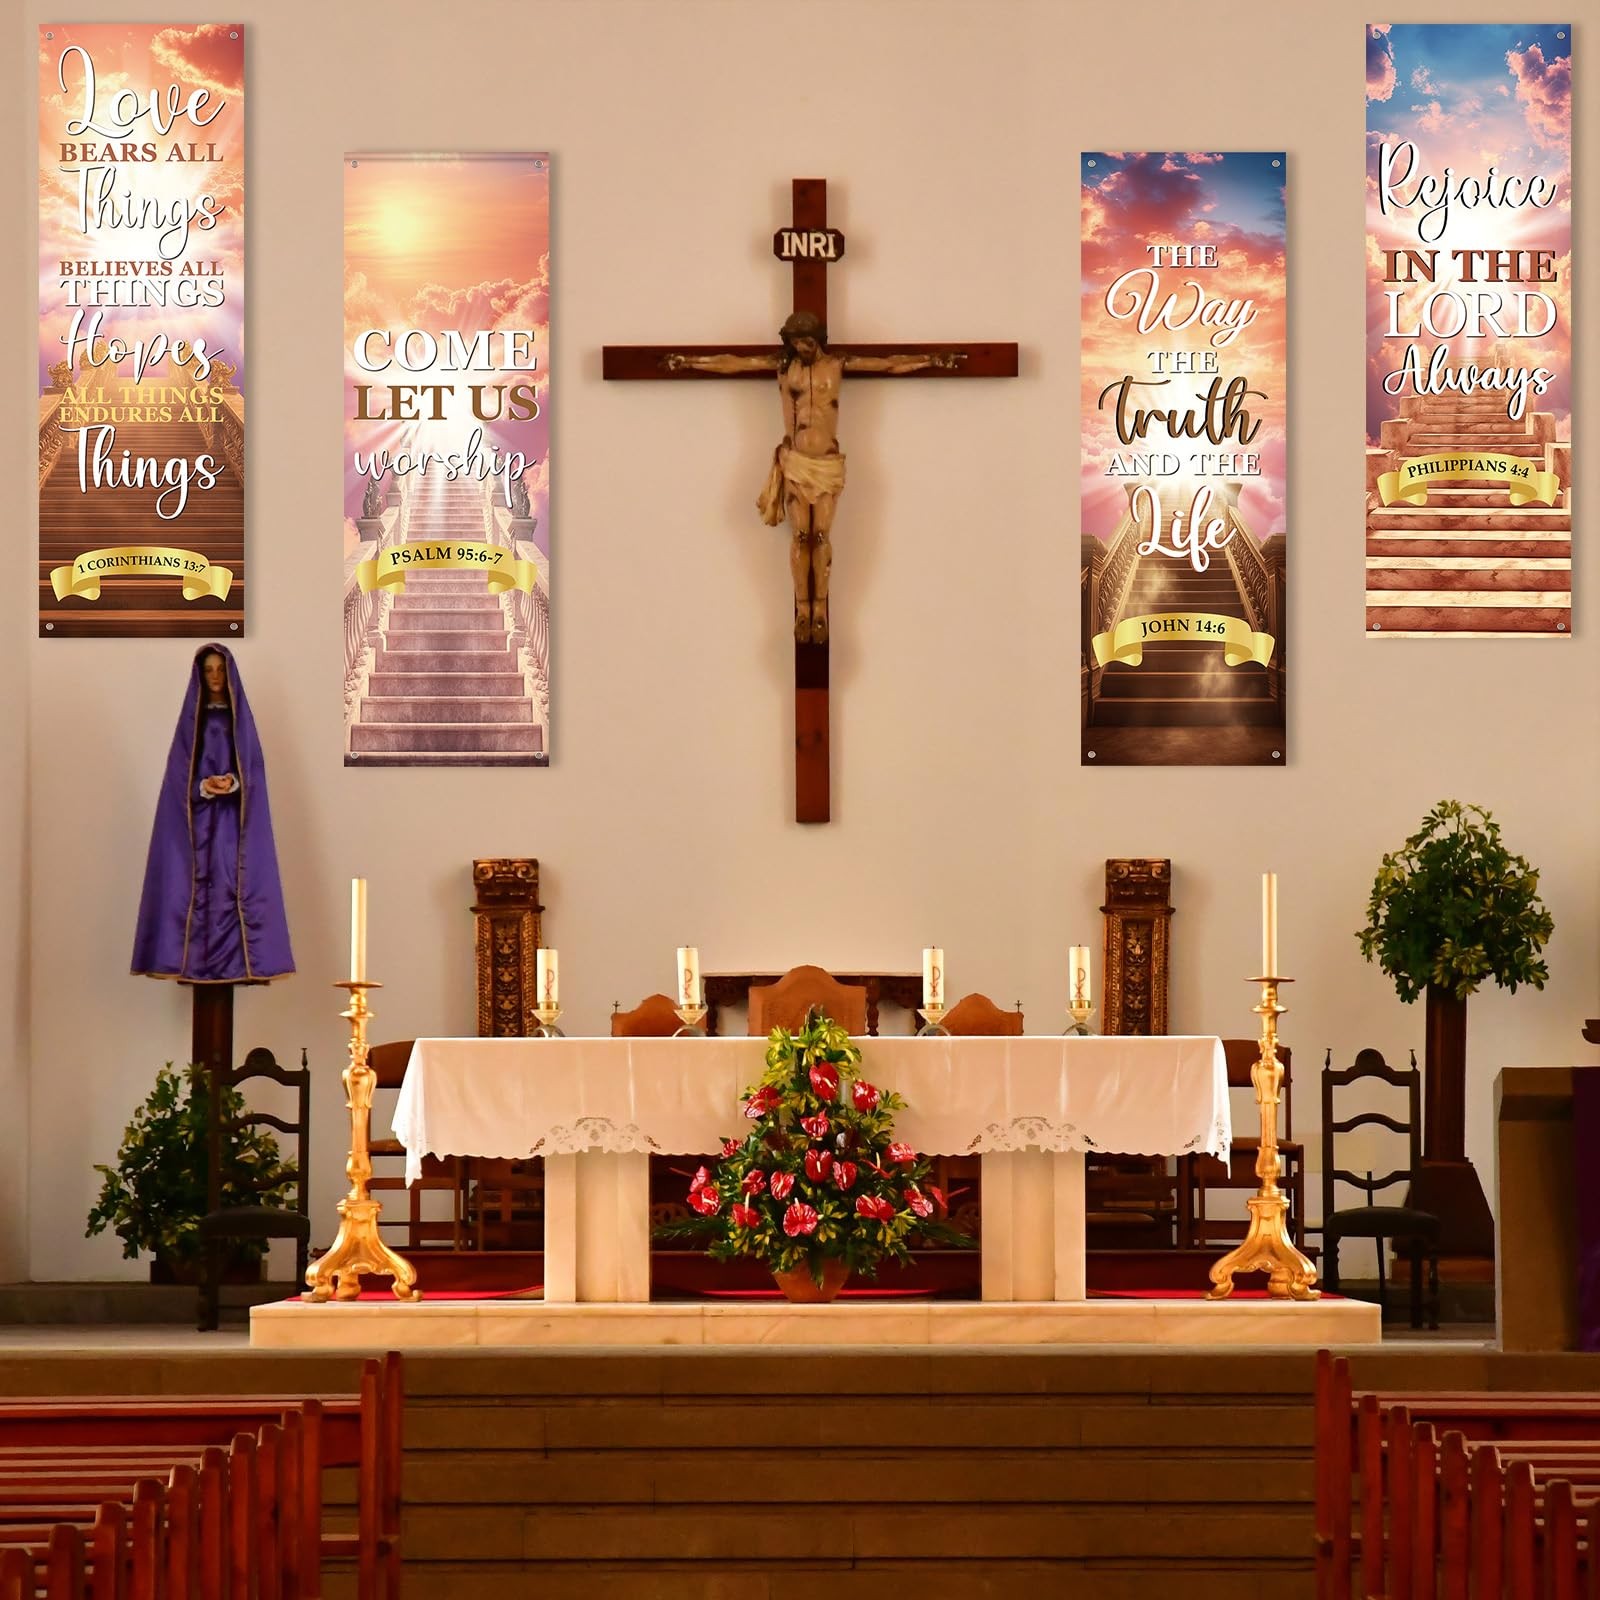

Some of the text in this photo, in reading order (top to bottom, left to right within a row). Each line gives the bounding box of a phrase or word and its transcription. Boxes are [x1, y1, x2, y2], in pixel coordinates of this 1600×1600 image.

[58, 45, 226, 139] Love
[59, 143, 224, 162] BEARS ALL
[1379, 141, 1558, 243] Rejoice
[59, 165, 225, 260] Things
[781, 232, 836, 258] INRI
[1147, 245, 1219, 268] THE
[59, 261, 224, 276] BELIEVES ALL
[1383, 250, 1557, 282] IN THE
[59, 279, 225, 307] THINGS
[1105, 268, 1259, 348] Way
[1384, 291, 1557, 338] LORD
[59, 308, 225, 384] Hopes
[353, 329, 537, 372] COME
[1147, 351, 1219, 374] THE
[59, 386, 224, 405] ALL THINGS
[1383, 344, 1557, 420] Always
[59, 406, 224, 423] ENDURES ALL
[353, 384, 539, 421] LET US
[59, 424, 225, 520] Things
[354, 427, 536, 508] worship
[1105, 453, 1262, 476] AND THE
[1407, 459, 1530, 478] PHILIPPIANS 4:4
[1130, 485, 1237, 573] Life
[77, 555, 206, 574] 1 CORINTHIANS 13:7
[391, 547, 503, 566] PSALM 95:6-7
[1141, 619, 1226, 637] JOHN 14:6
